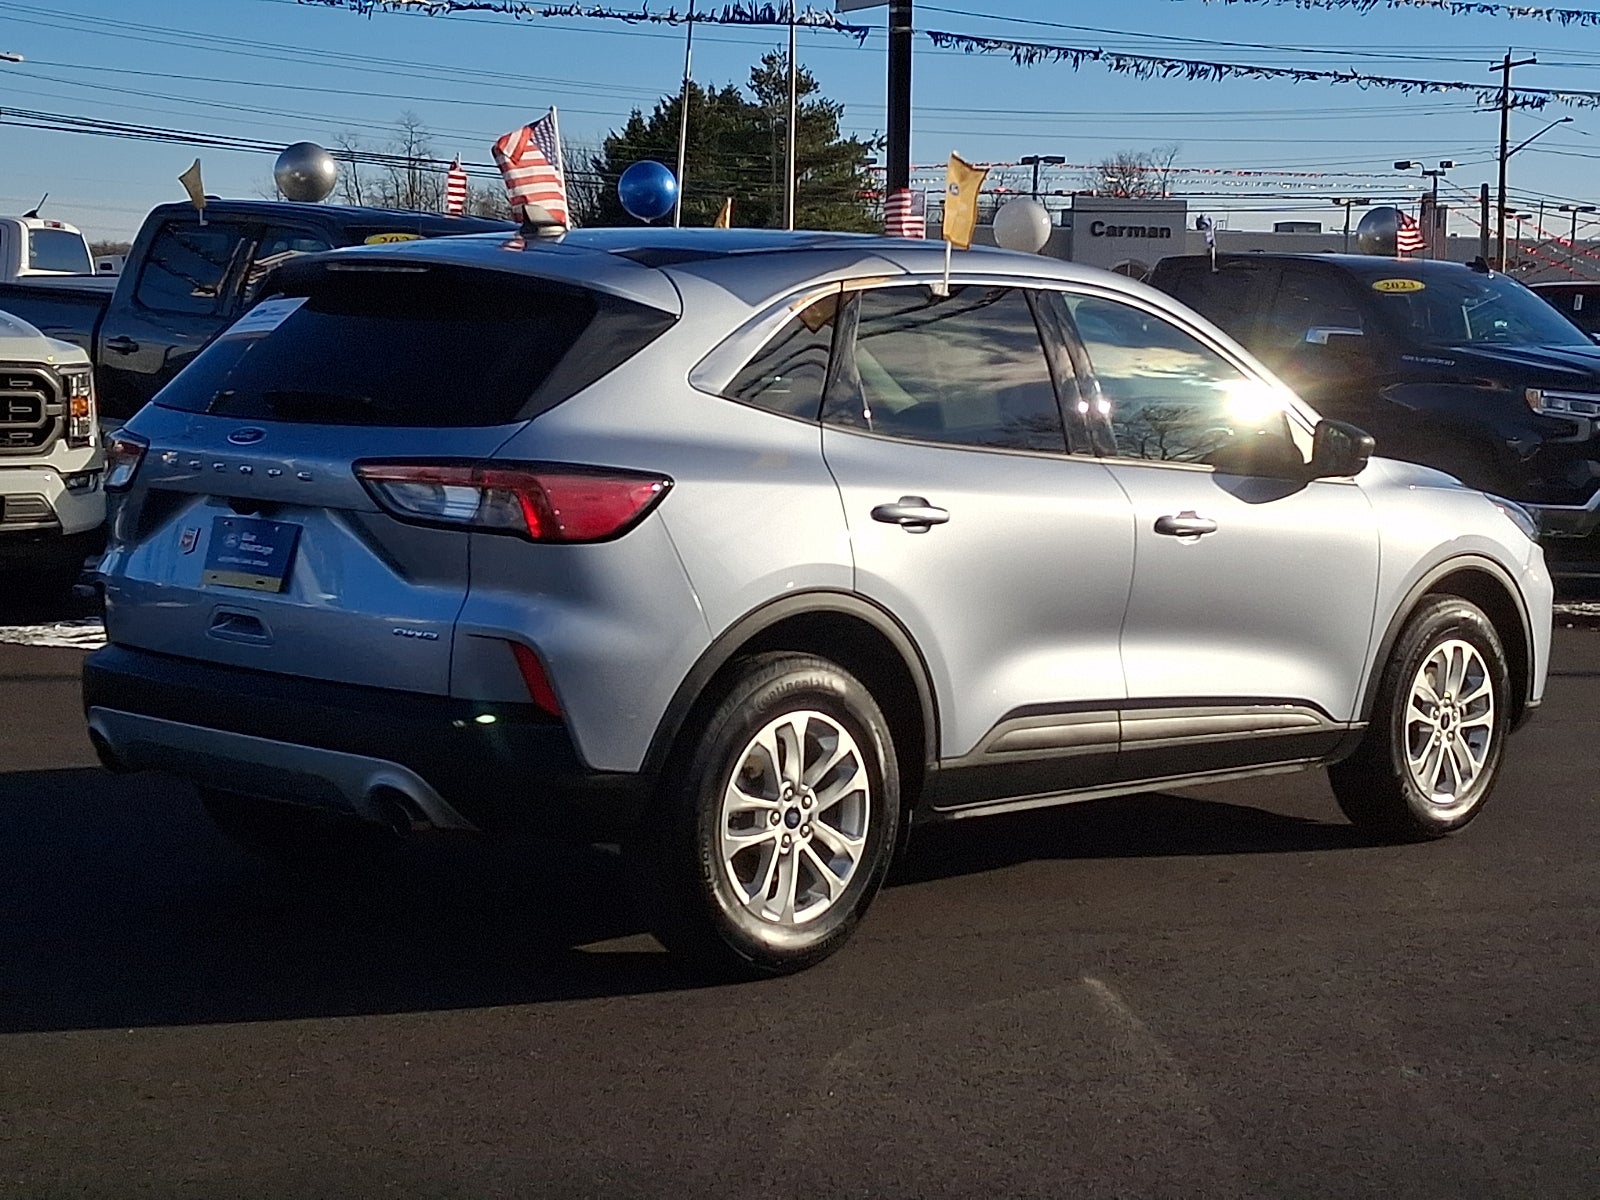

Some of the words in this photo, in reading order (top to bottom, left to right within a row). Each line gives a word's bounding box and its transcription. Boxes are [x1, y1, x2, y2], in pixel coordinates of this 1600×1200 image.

[1090, 220, 1171, 239] Carman
[1384, 279, 1416, 290] 2023
[162, 451, 313, 481] ESCAPE
